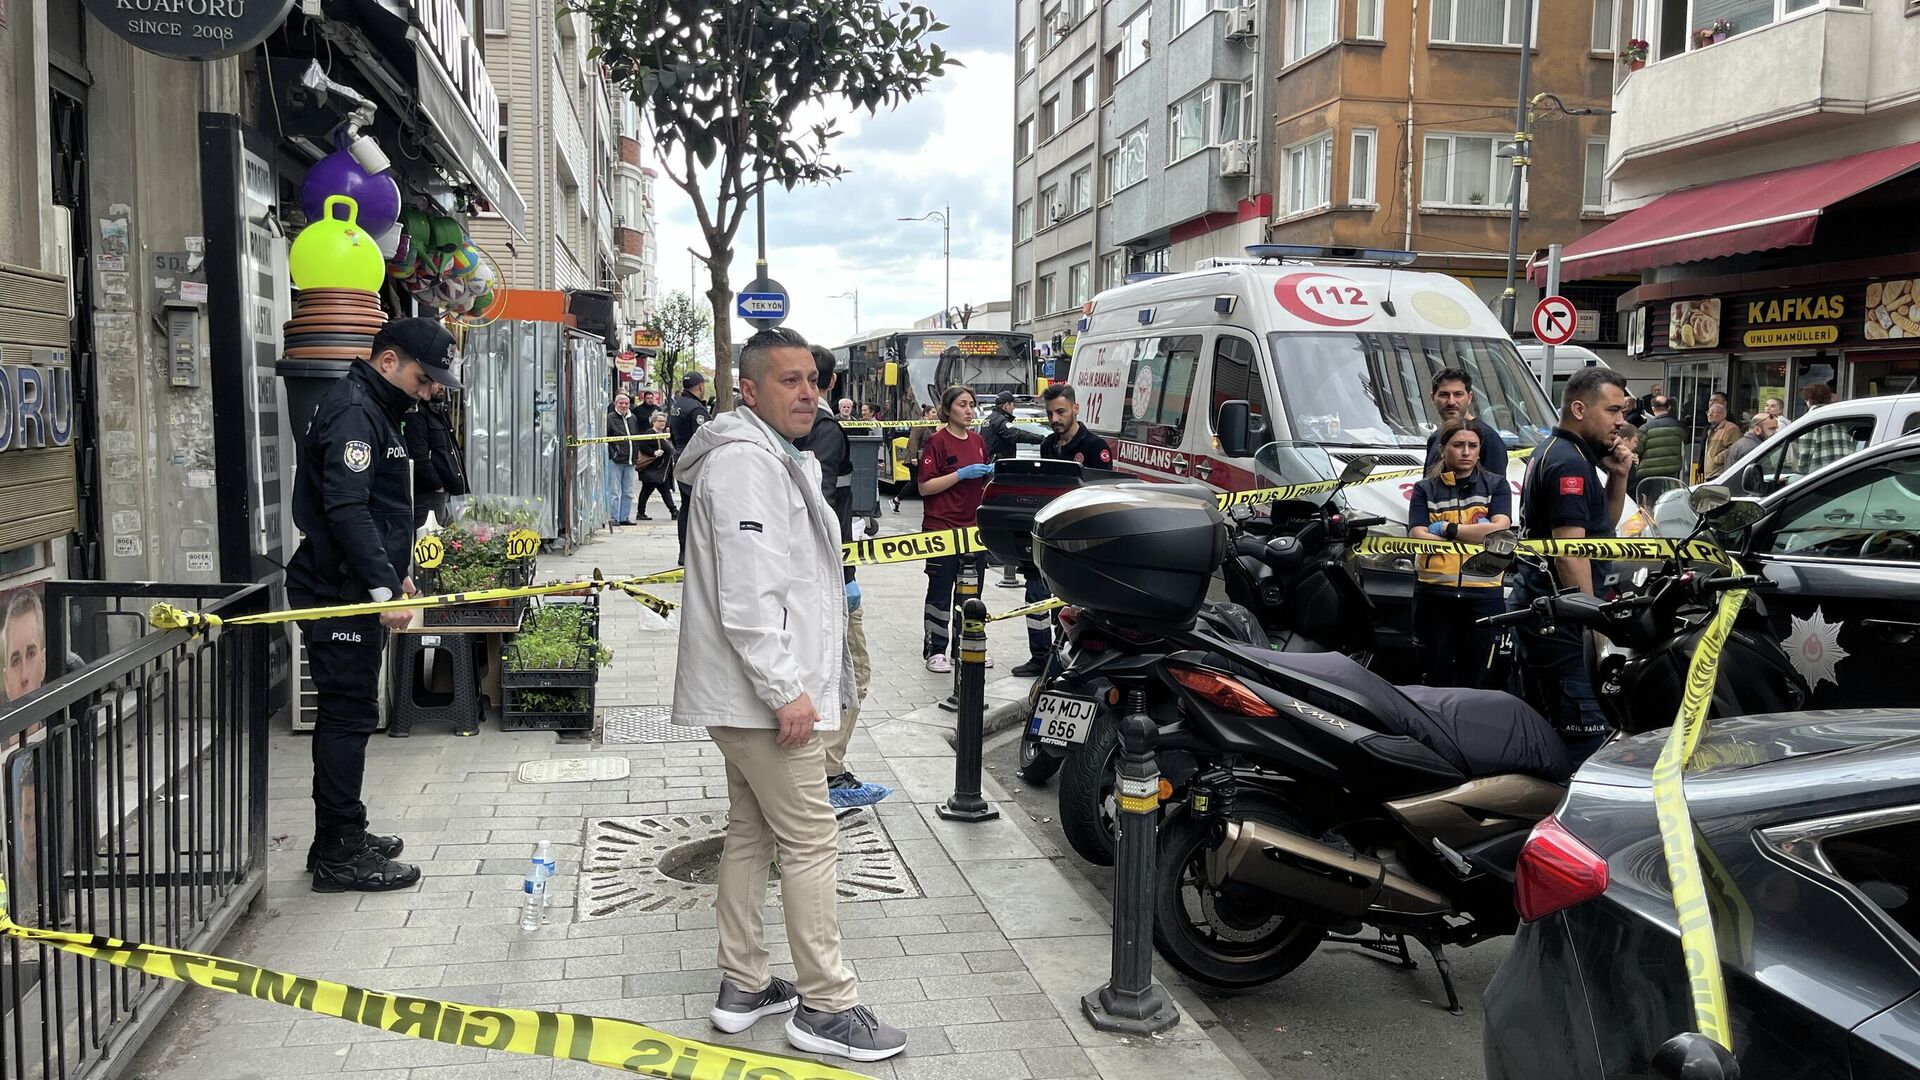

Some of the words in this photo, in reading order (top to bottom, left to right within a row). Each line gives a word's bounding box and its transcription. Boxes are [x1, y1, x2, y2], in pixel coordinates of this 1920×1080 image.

[128, 18, 182, 36] SİNCE
[192, 25, 234, 40] 2008
[1305, 286, 1369, 306] 112
[767, 302, 782, 310] YÖN
[1748, 295, 1844, 323] KAFKAS
[1750, 334, 1773, 344] UNLU
[1776, 328, 1831, 342] MAMÜLLERİ
[1085, 393, 1103, 424] 112
[387, 446, 407, 459] POL
[1119, 443, 1172, 470] AMBULANS
[416, 542, 438, 563] 100
[508, 537, 535, 556] 100
[881, 535, 946, 559] POLİS
[1564, 542, 1672, 560] GİRİLMEZ
[331, 632, 362, 643] POLİS
[1039, 697, 1056, 714] 34
[1058, 700, 1092, 720] MDJ
[1047, 720, 1076, 739] 656
[1040, 736, 1068, 747] DAYTONA
